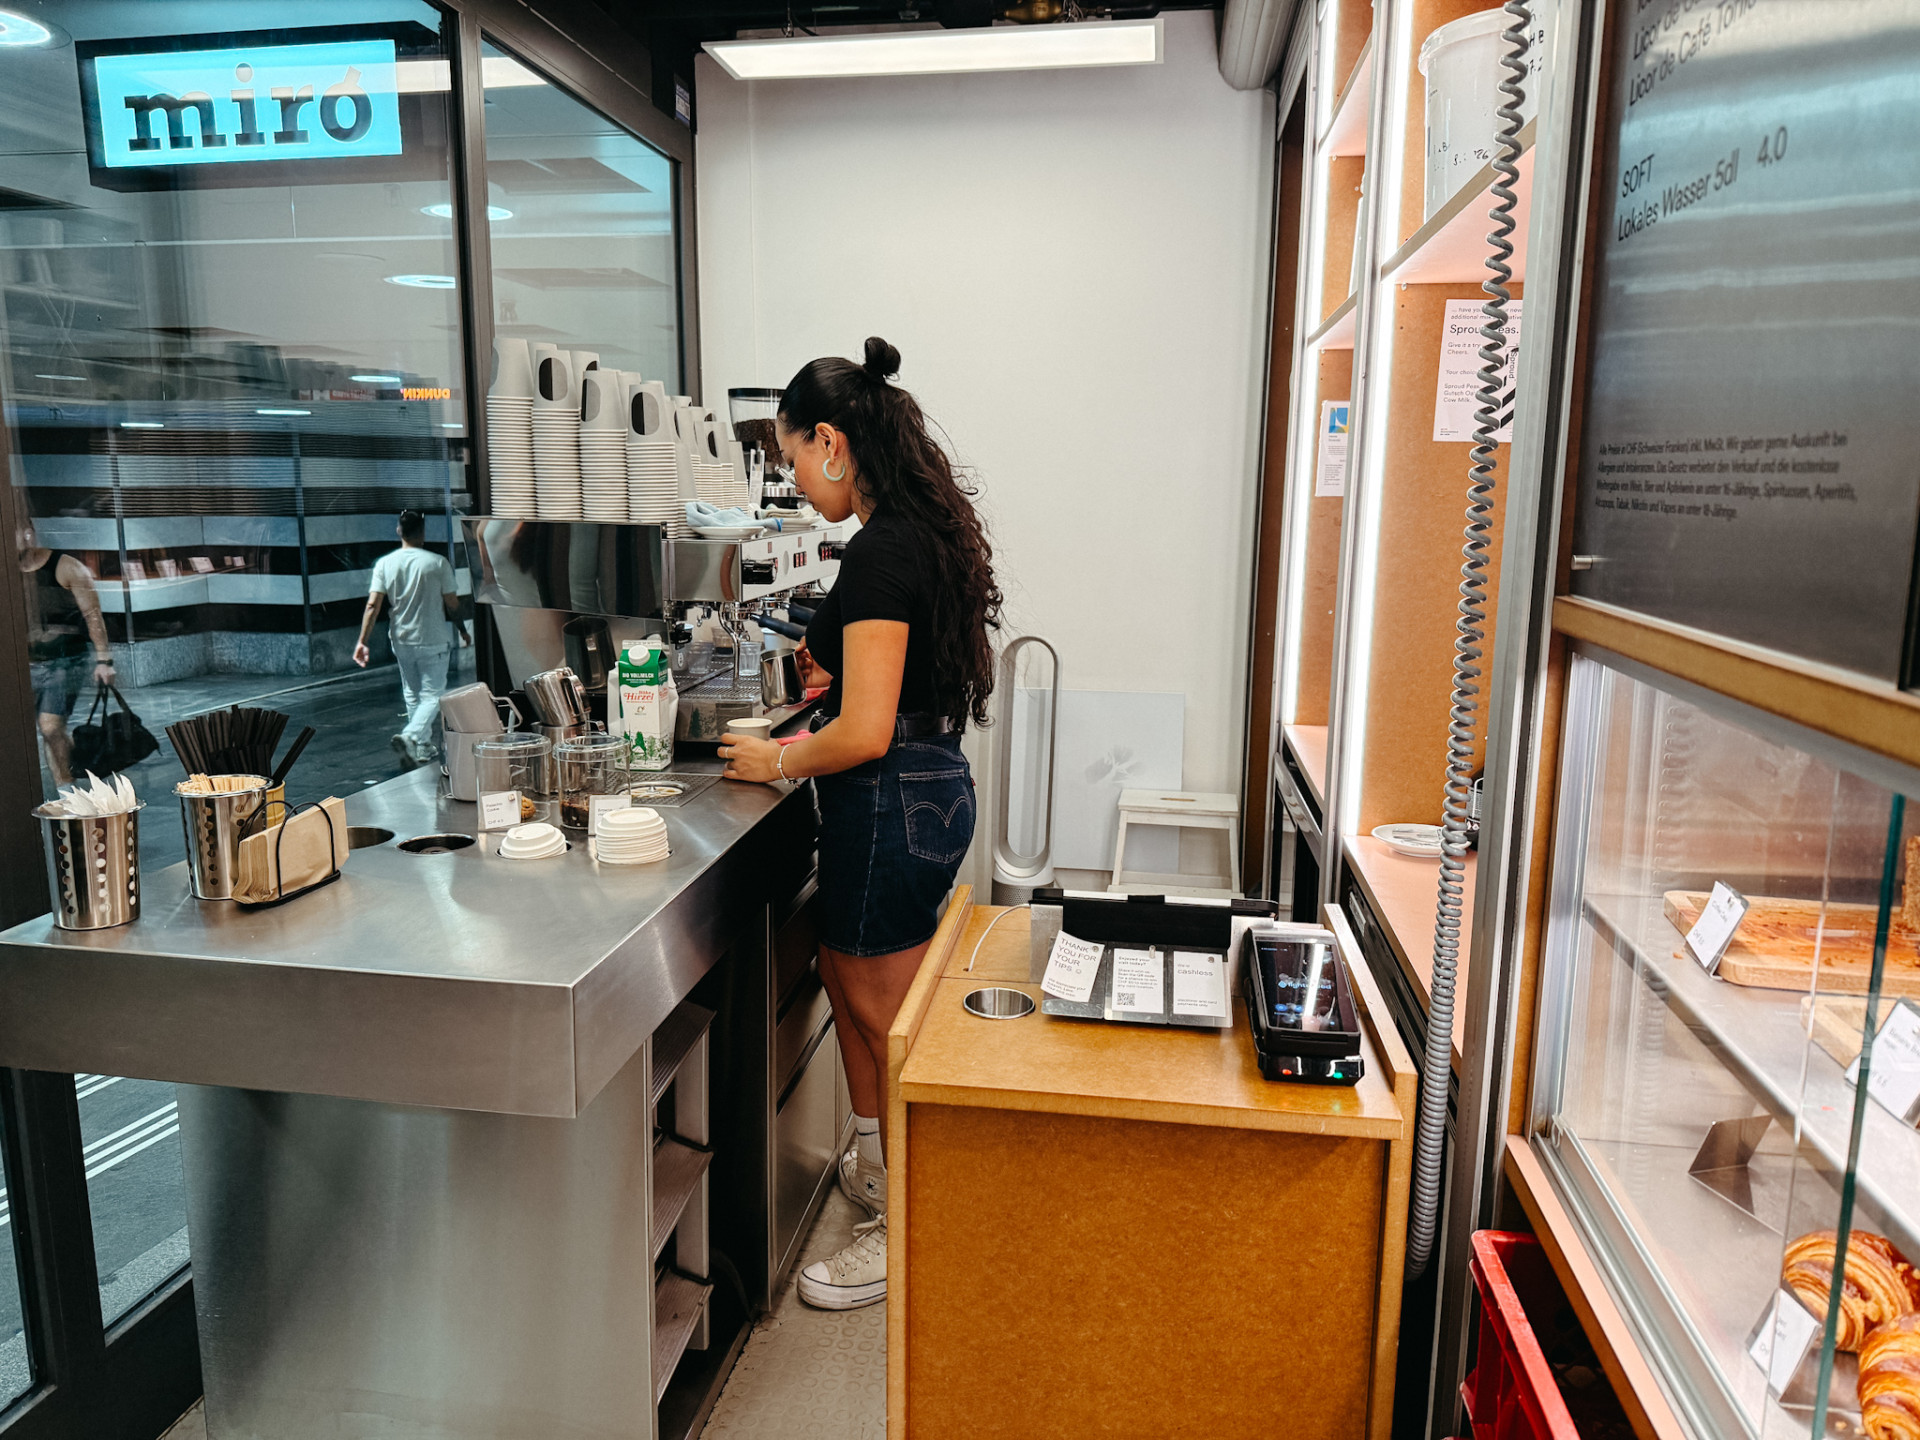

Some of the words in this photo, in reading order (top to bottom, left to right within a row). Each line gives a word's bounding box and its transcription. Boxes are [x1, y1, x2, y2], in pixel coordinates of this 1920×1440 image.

[1633, 18, 1661, 60] Licor
[1664, 0, 1681, 31] de
[1629, 66, 1658, 107] Licor
[1660, 48, 1676, 81] de
[1679, 12, 1712, 64] Café
[124, 62, 373, 152] miró
[1618, 200, 1658, 242] Lokales
[1663, 174, 1712, 218] Wasser
[1713, 147, 1740, 192] 5dl
[1757, 125, 1788, 168] 4.0
[1622, 153, 1655, 198] SOFT
[1450, 323, 1480, 336] Sprou
[1498, 327, 1520, 336] eas.
[1508, 351, 1518, 379] Sproud
[624, 692, 655, 700] Hirzel
[1059, 945, 1077, 957] YOU
[1078, 953, 1097, 962] FOR
[1062, 938, 1089, 953] THANK
[1054, 960, 1073, 972] TIPS
[1056, 952, 1081, 967] YOUR
[1177, 969, 1214, 977] cashless
